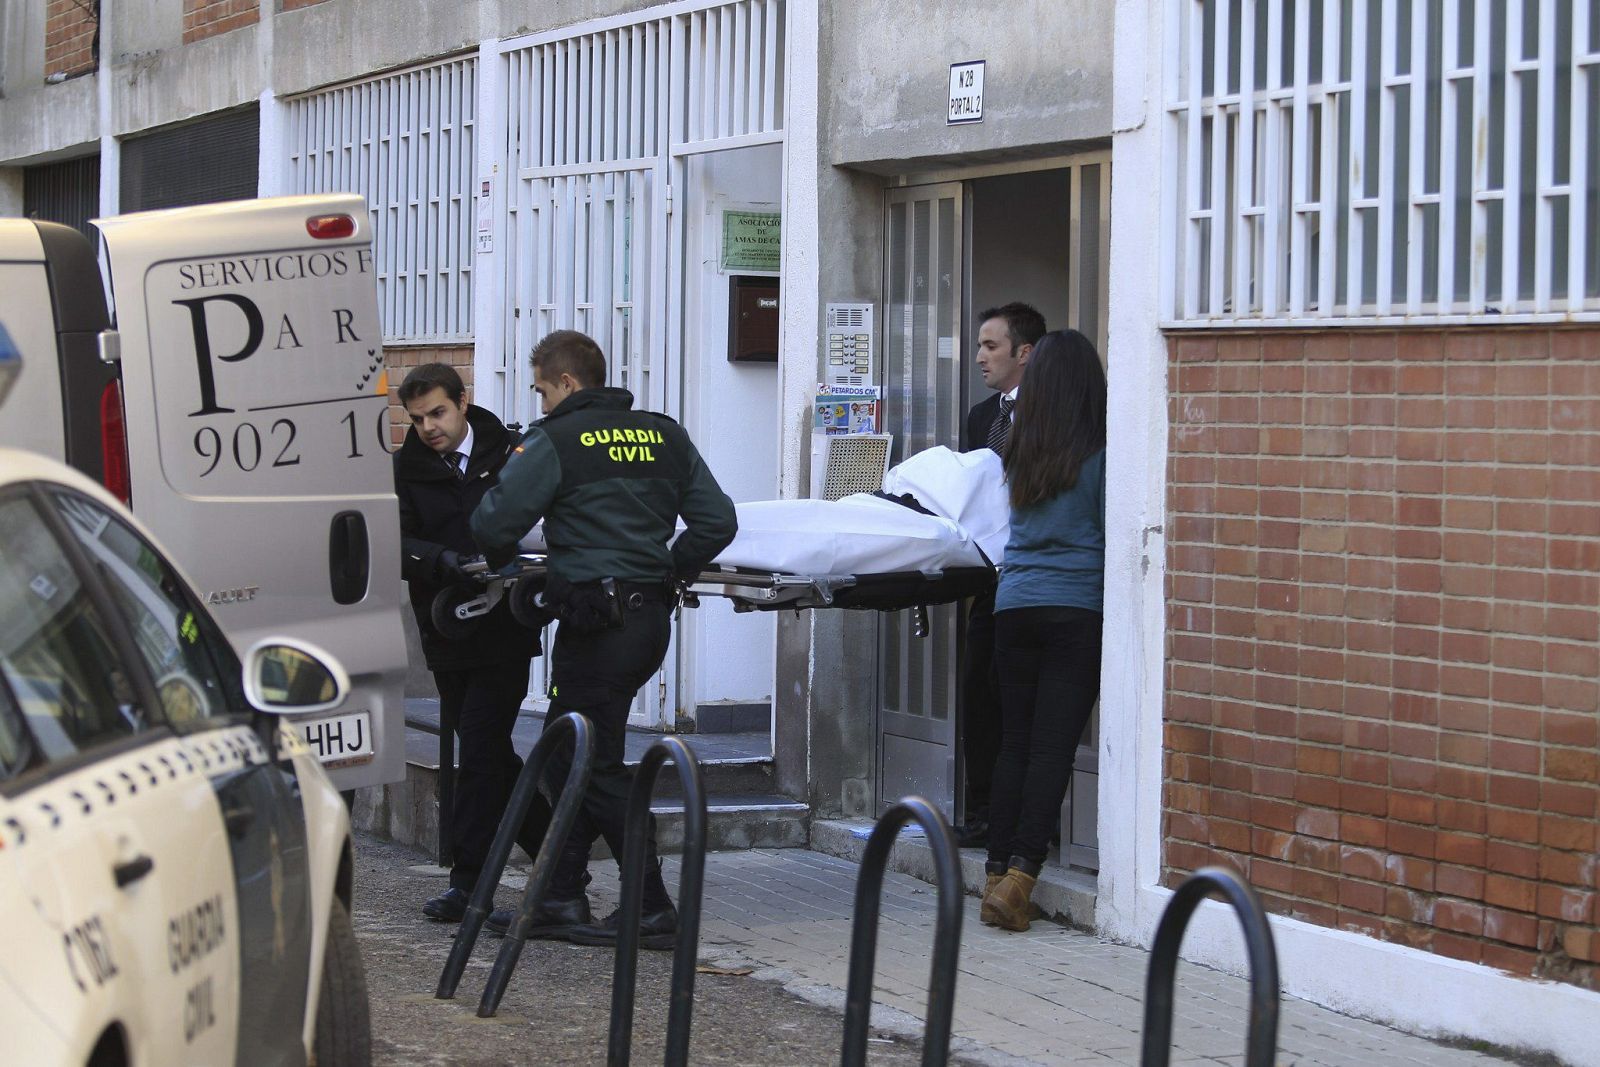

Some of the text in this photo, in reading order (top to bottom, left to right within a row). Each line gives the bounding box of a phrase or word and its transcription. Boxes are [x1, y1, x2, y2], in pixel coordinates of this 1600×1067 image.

[965, 70, 974, 87] 28
[950, 95, 981, 115] PORTAL 2
[180, 251, 348, 290] SERVICIOS
[831, 387, 864, 395] PETARDOS
[580, 428, 666, 447] GUARDIA
[193, 418, 301, 478] 902
[608, 446, 655, 462] CIVIL
